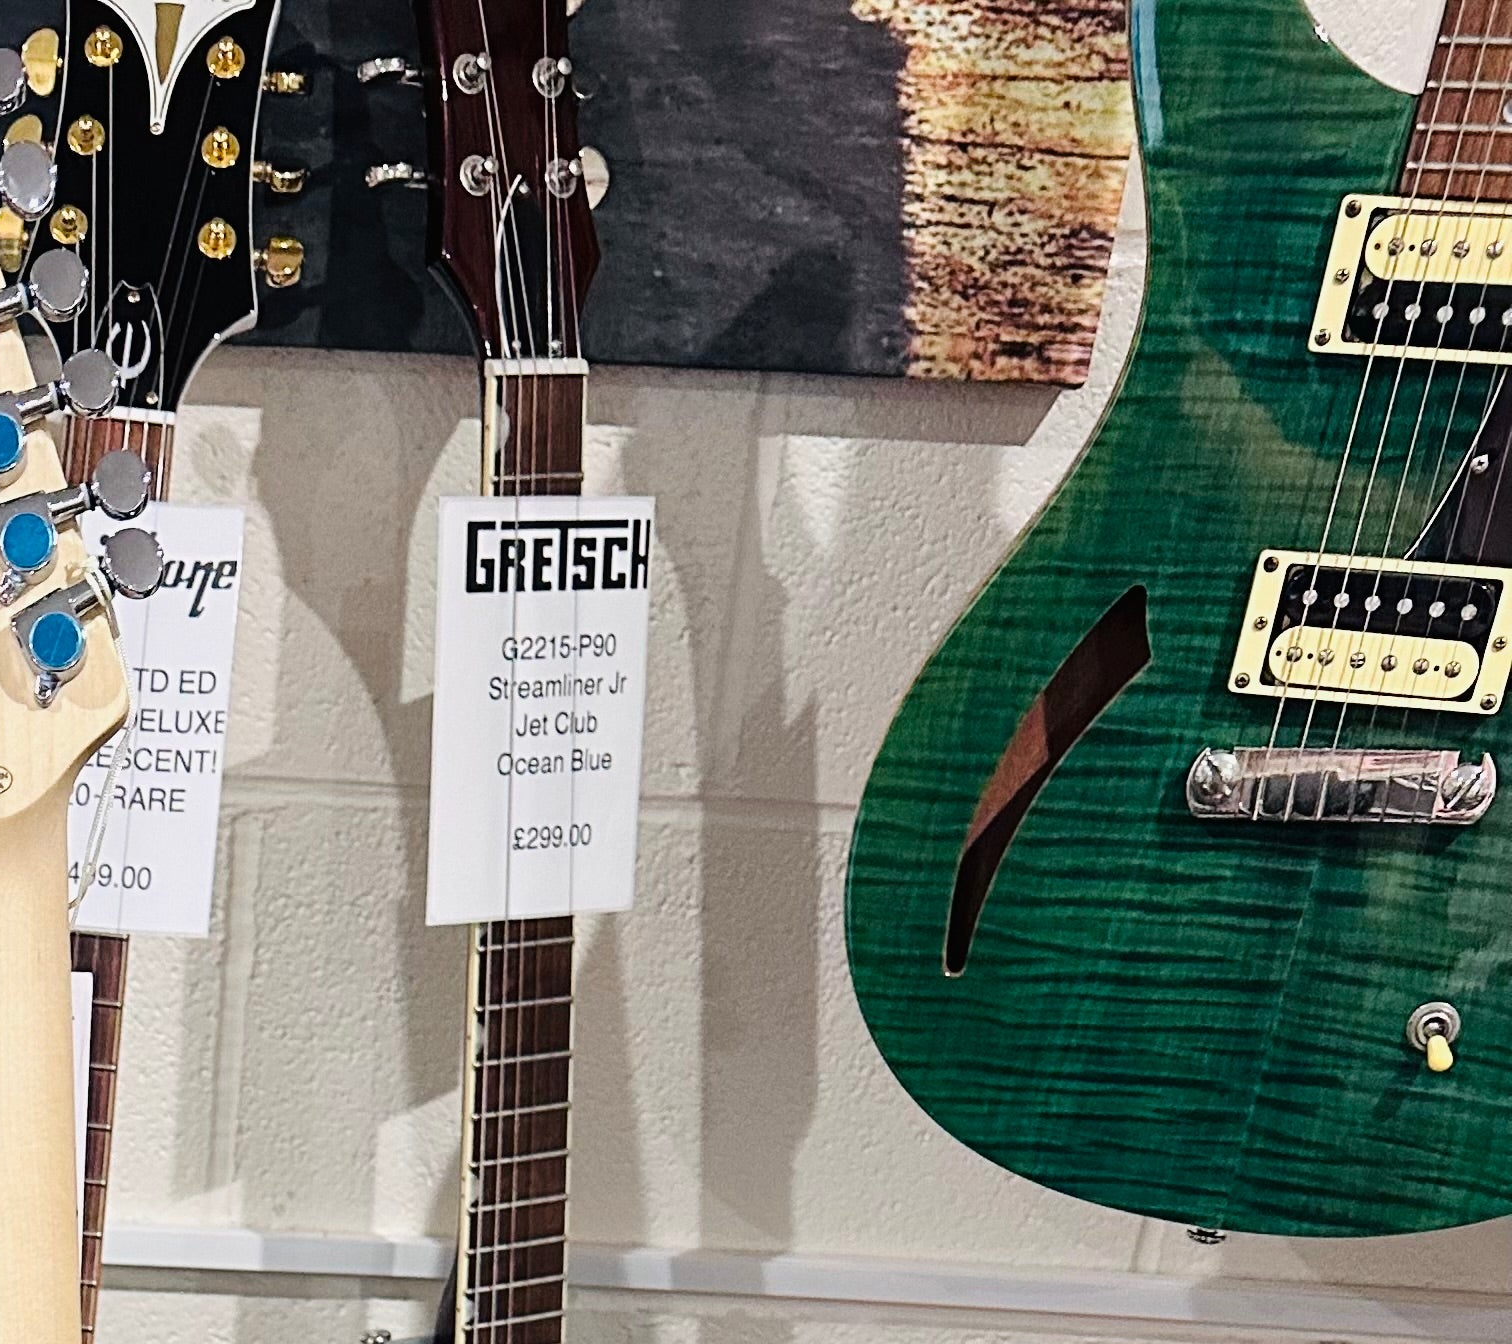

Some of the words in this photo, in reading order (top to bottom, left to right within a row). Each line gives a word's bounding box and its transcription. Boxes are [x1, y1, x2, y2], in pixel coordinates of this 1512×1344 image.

[466, 519, 651, 593] GRETSCH
[501, 633, 617, 661] G2215-P90
[179, 670, 217, 694] ED
[488, 674, 604, 701] Streamliner
[609, 670, 628, 695] Jr
[515, 713, 549, 737] Jet
[554, 710, 598, 735] Club
[496, 752, 565, 776] Ocean
[571, 748, 613, 772] Blue
[512, 823, 593, 851] £299.00
